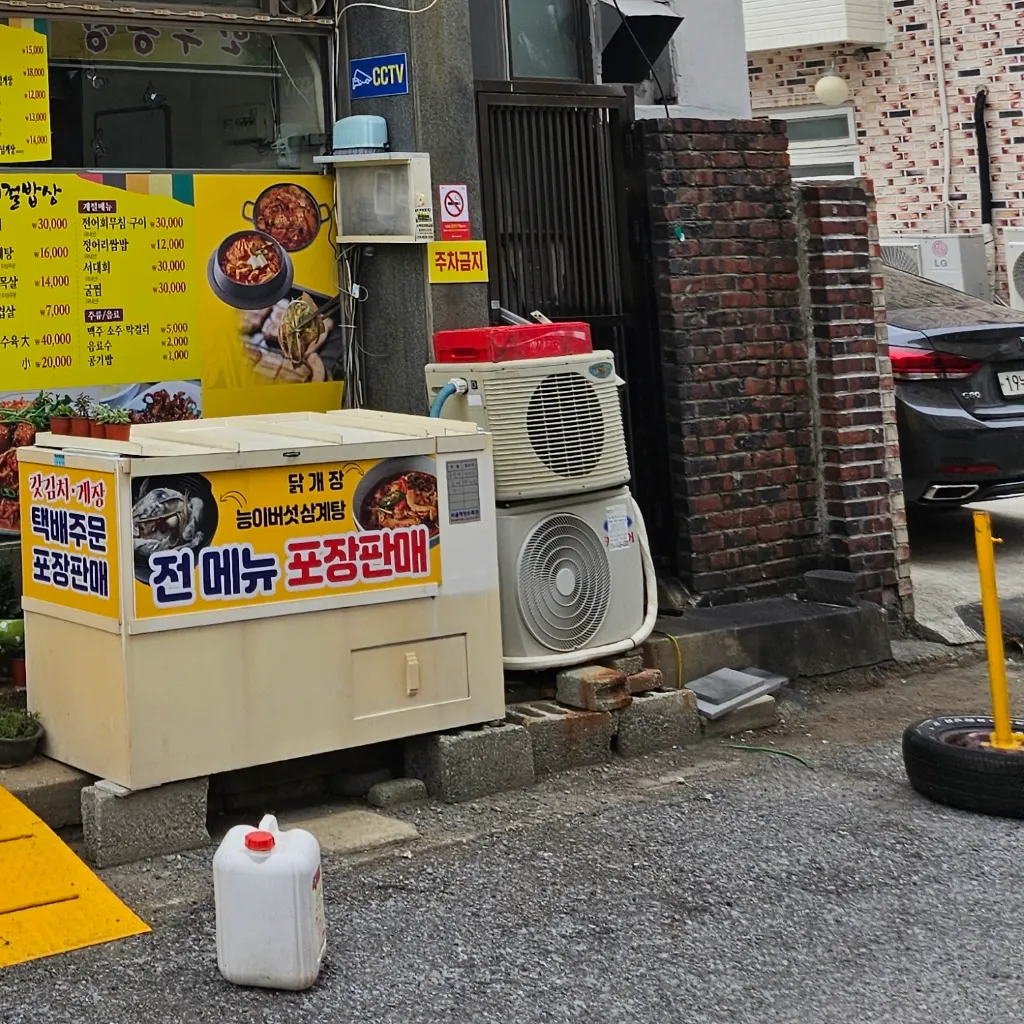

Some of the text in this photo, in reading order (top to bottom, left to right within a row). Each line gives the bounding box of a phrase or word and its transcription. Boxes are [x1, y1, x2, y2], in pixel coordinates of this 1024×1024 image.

[372, 64, 404, 86] CCTV
[83, 202, 113, 212] 계절메뉴
[83, 238, 129, 252] 정어리쌈밥
[83, 260, 110, 274] 서대회
[435, 251, 483, 272] 주차금지
[934, 259, 947, 268] LG
[84, 283, 102, 296] 굴찜
[88, 310, 121, 321] 주류/음료
[21, 335, 30, 347] 大
[87, 340, 112, 352] 음료수
[22, 357, 30, 370] 小
[88, 354, 113, 366] 공기밥
[31, 506, 107, 552] 택배주문
[33, 548, 109, 597] 포장판매
[153, 529, 427, 604] 전 메뉴 포장판매
